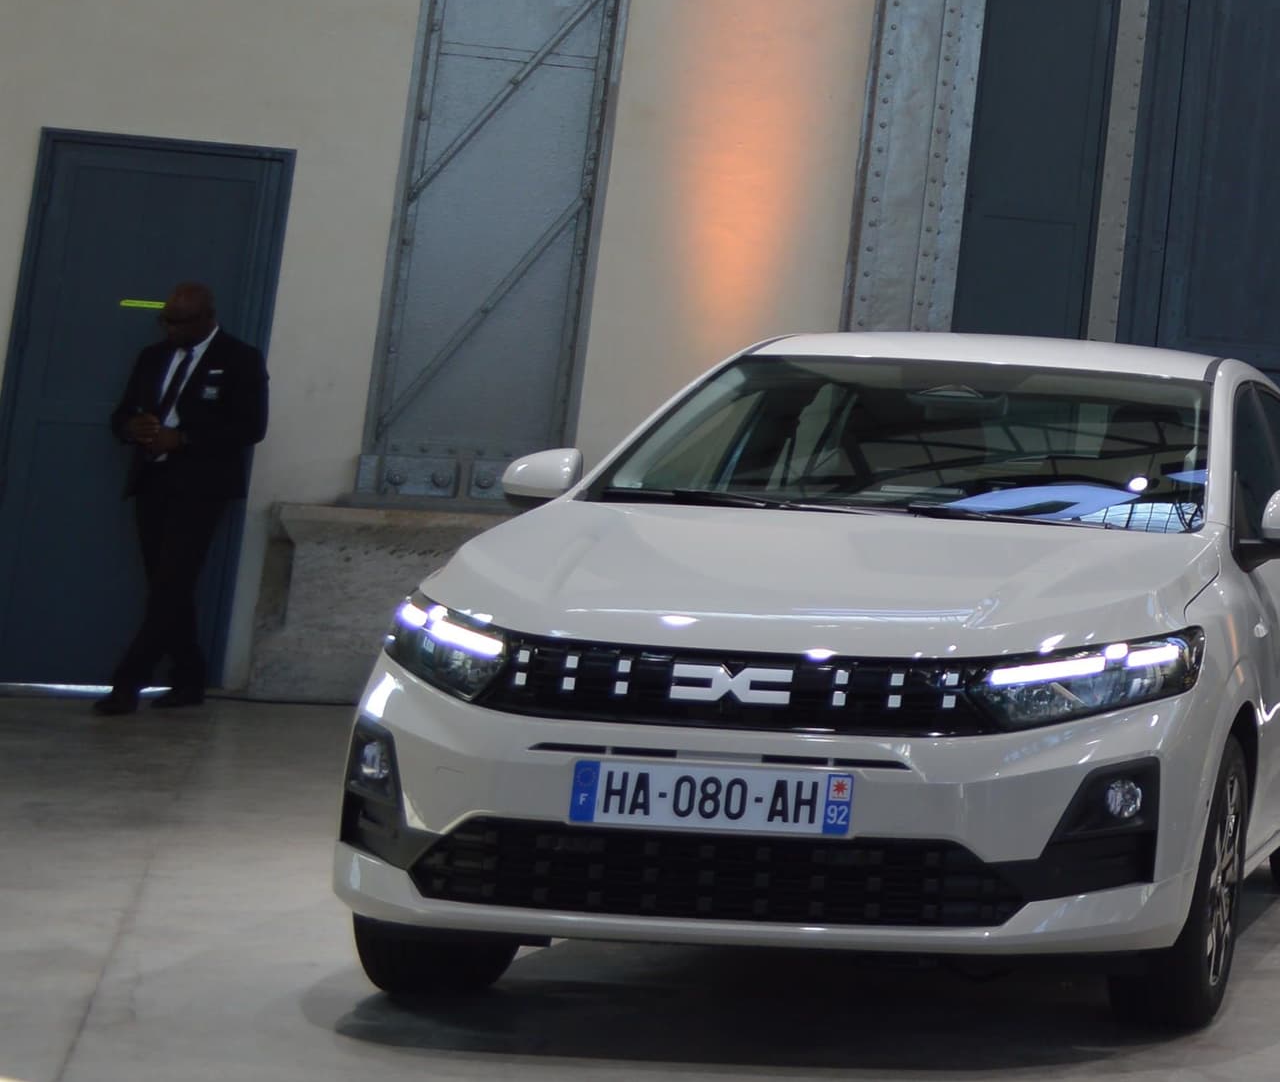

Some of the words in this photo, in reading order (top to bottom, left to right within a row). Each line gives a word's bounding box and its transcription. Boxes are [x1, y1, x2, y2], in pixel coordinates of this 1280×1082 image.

[578, 792, 588, 805] F
[602, 770, 819, 824] HA-080-AH
[826, 804, 849, 825] 92
